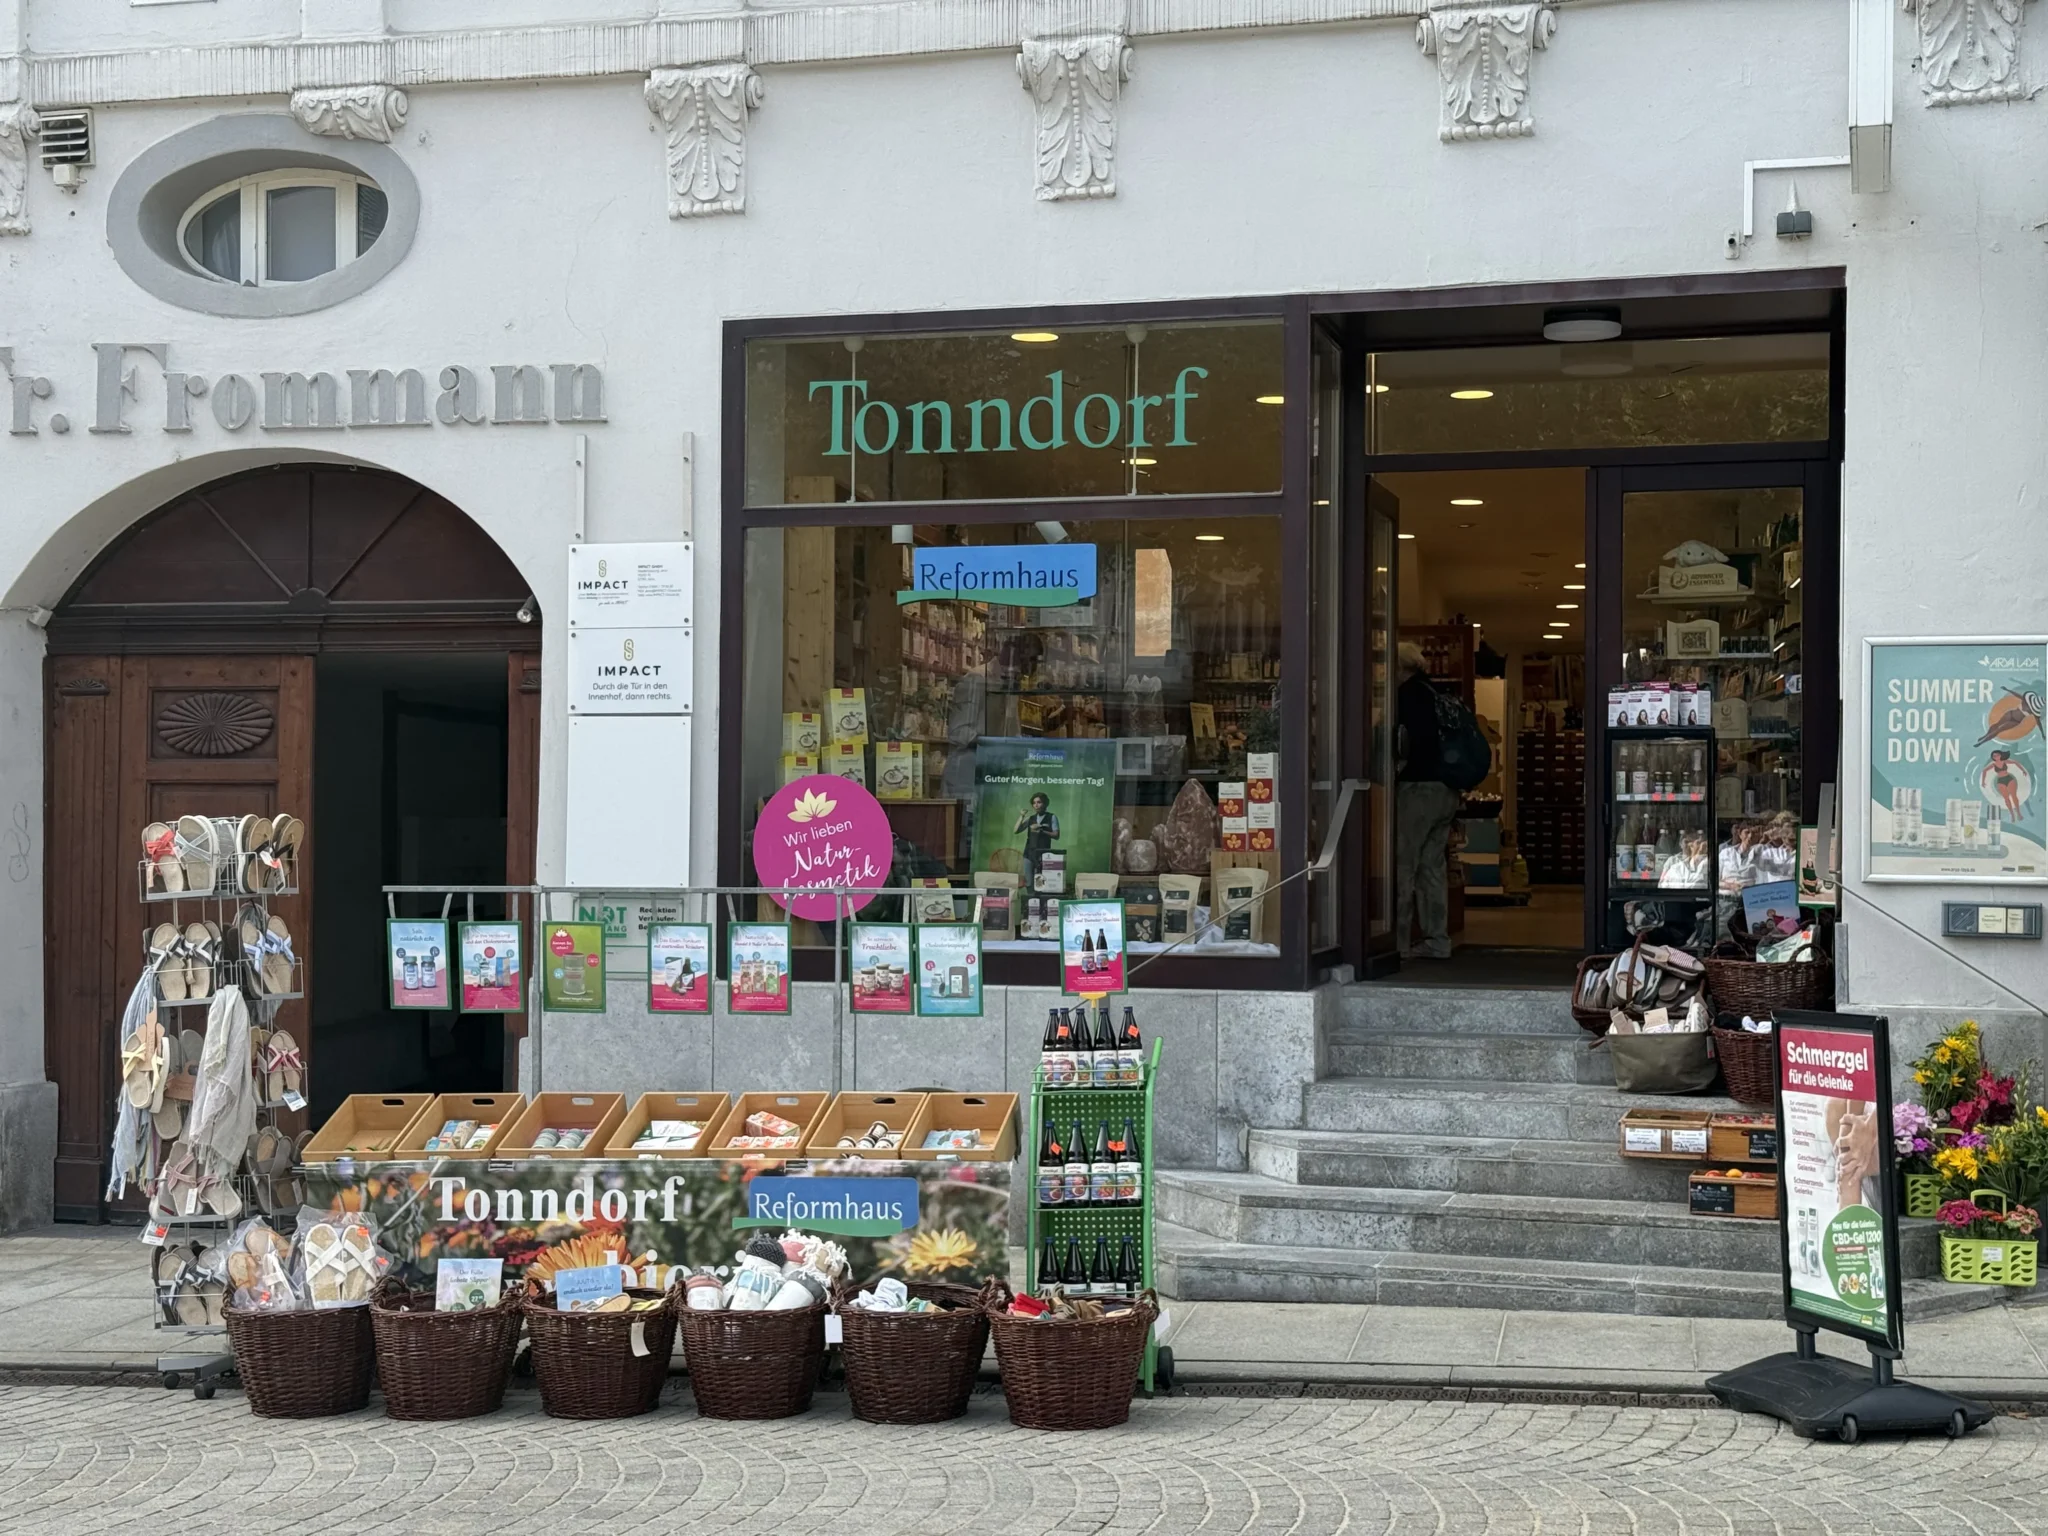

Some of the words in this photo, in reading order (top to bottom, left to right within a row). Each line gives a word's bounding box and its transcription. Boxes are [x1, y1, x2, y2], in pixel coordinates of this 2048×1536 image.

[88, 342, 608, 434] Frommann
[808, 366, 1209, 456] Tonndorf
[578, 581, 629, 590] IMPACT
[920, 561, 1079, 599] Reformhaus
[598, 665, 662, 676] IMPACT
[1989, 657, 2015, 668] ARYA
[588, 693, 624, 701] Innenhof,
[625, 693, 645, 701] dann
[647, 692, 672, 700] rechts.
[592, 682, 615, 690] Durch
[617, 682, 629, 690] die
[630, 682, 642, 690] Tür
[644, 682, 651, 690] in
[653, 682, 668, 690] den
[1887, 678, 1994, 704] SUMMER
[1888, 708, 1952, 733] COOL
[1028, 751, 1064, 761] Reformhaus
[1887, 738, 1960, 763] DOWN
[984, 775, 1010, 783] Guter
[1011, 775, 1045, 785] Morgen,
[1047, 776, 1085, 785] besserer
[1086, 777, 1105, 787] Tag!
[783, 830, 808, 847] Wir
[810, 820, 853, 840] lieben
[791, 842, 862, 878] Natur-
[1786, 1041, 1869, 1074] Schmerzgel
[1788, 1068, 1802, 1085] für
[1803, 1070, 1817, 1087] die
[1817, 1073, 1854, 1091] Gelenke
[429, 1176, 686, 1223] Tonndorf
[754, 1192, 903, 1226] Reformhaus
[1832, 1231, 1865, 1245] CBD-Gel
[1865, 1230, 1881, 1243] 1200
